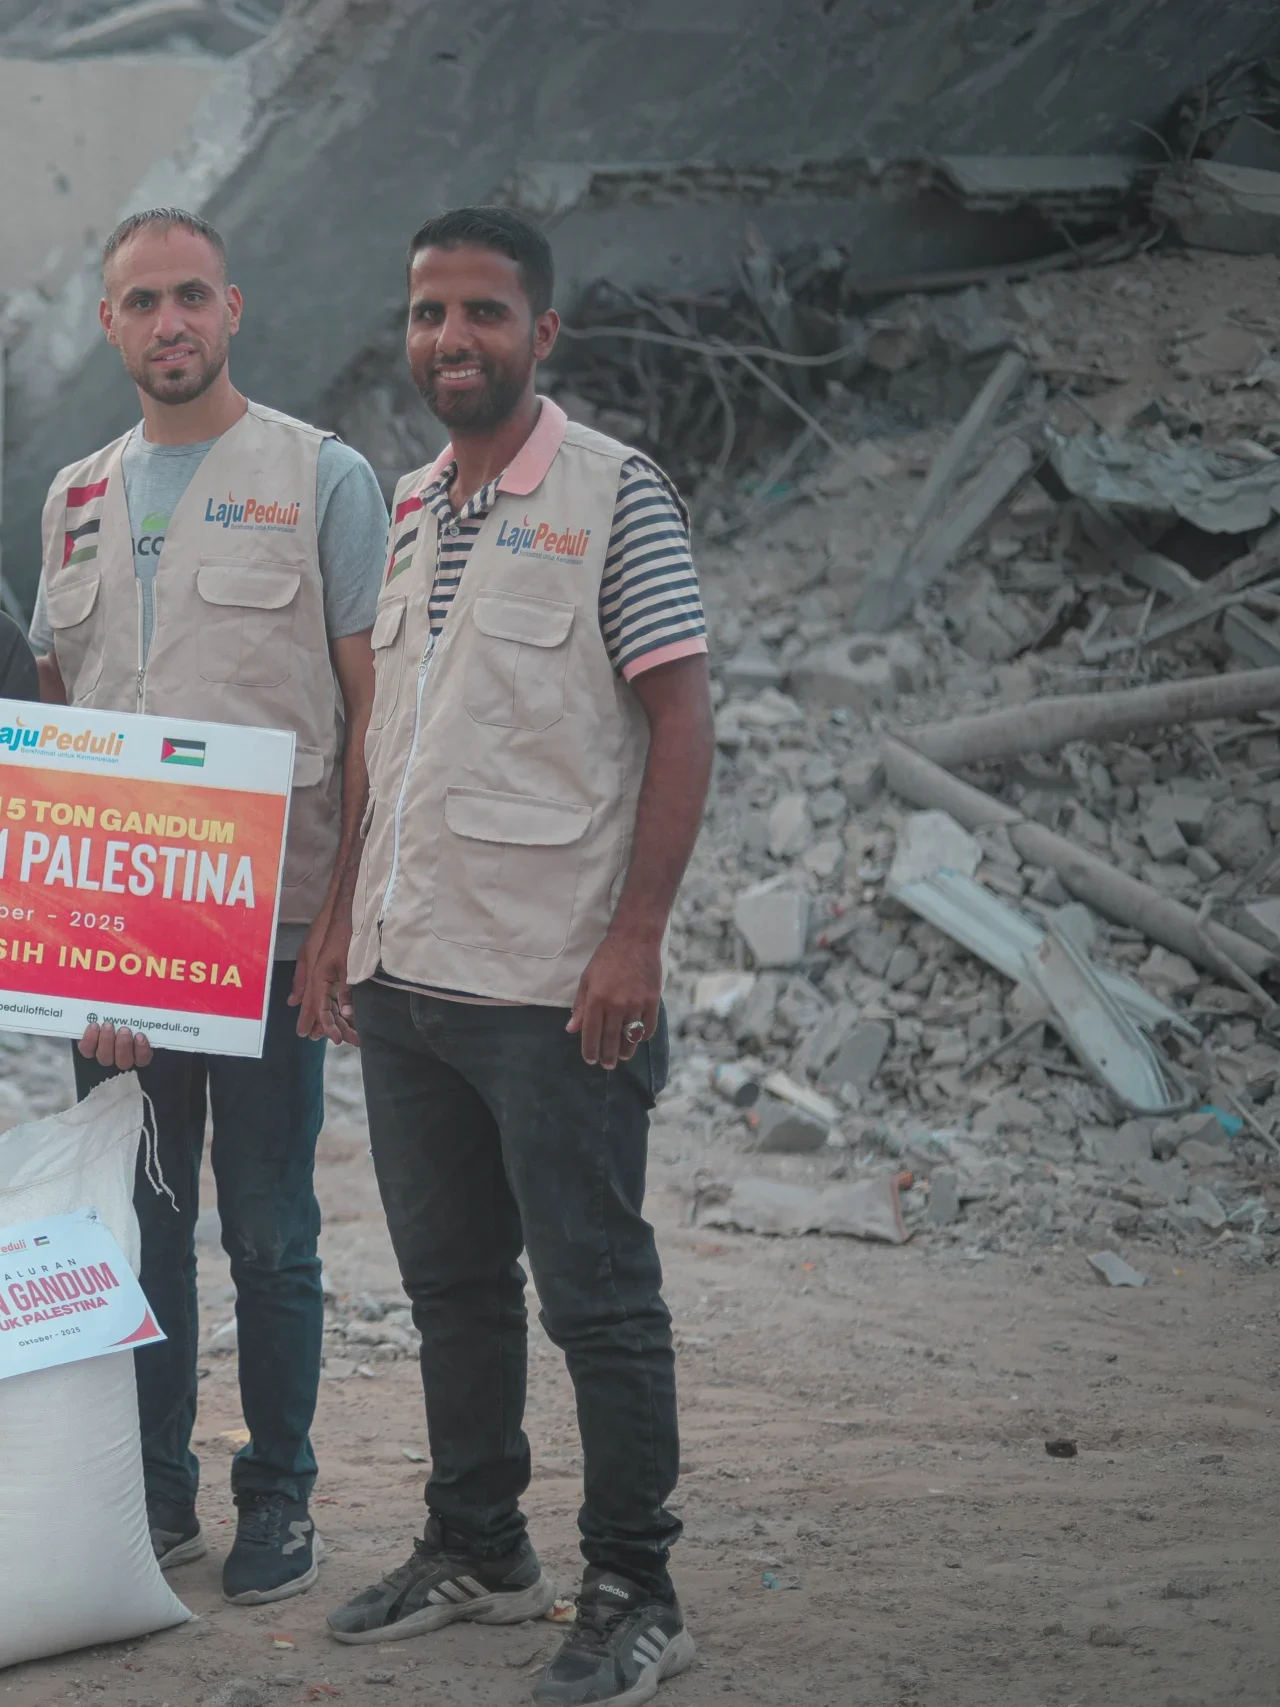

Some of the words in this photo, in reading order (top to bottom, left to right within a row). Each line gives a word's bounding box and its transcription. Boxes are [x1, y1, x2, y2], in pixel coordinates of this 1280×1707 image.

[205, 497, 300, 528] LajuPeduli
[20, 747, 56, 757] Berkhidmat
[58, 751, 75, 759] untuk
[6, 796, 26, 821] 5
[31, 800, 96, 829] TON
[100, 808, 236, 844] GANDUM
[21, 830, 256, 910] PALESTINA
[70, 911, 125, 933] 2025
[58, 945, 243, 989] INDONESIA
[103, 1016, 200, 1036] www.lajupeduli.org
[8, 1261, 120, 1311] GANDUM
[22, 1296, 108, 1326] PALESTINA
[18, 1333, 54, 1347] Oktober
[61, 1326, 82, 1337] 2025
[599, 1583, 629, 1600] adidas
